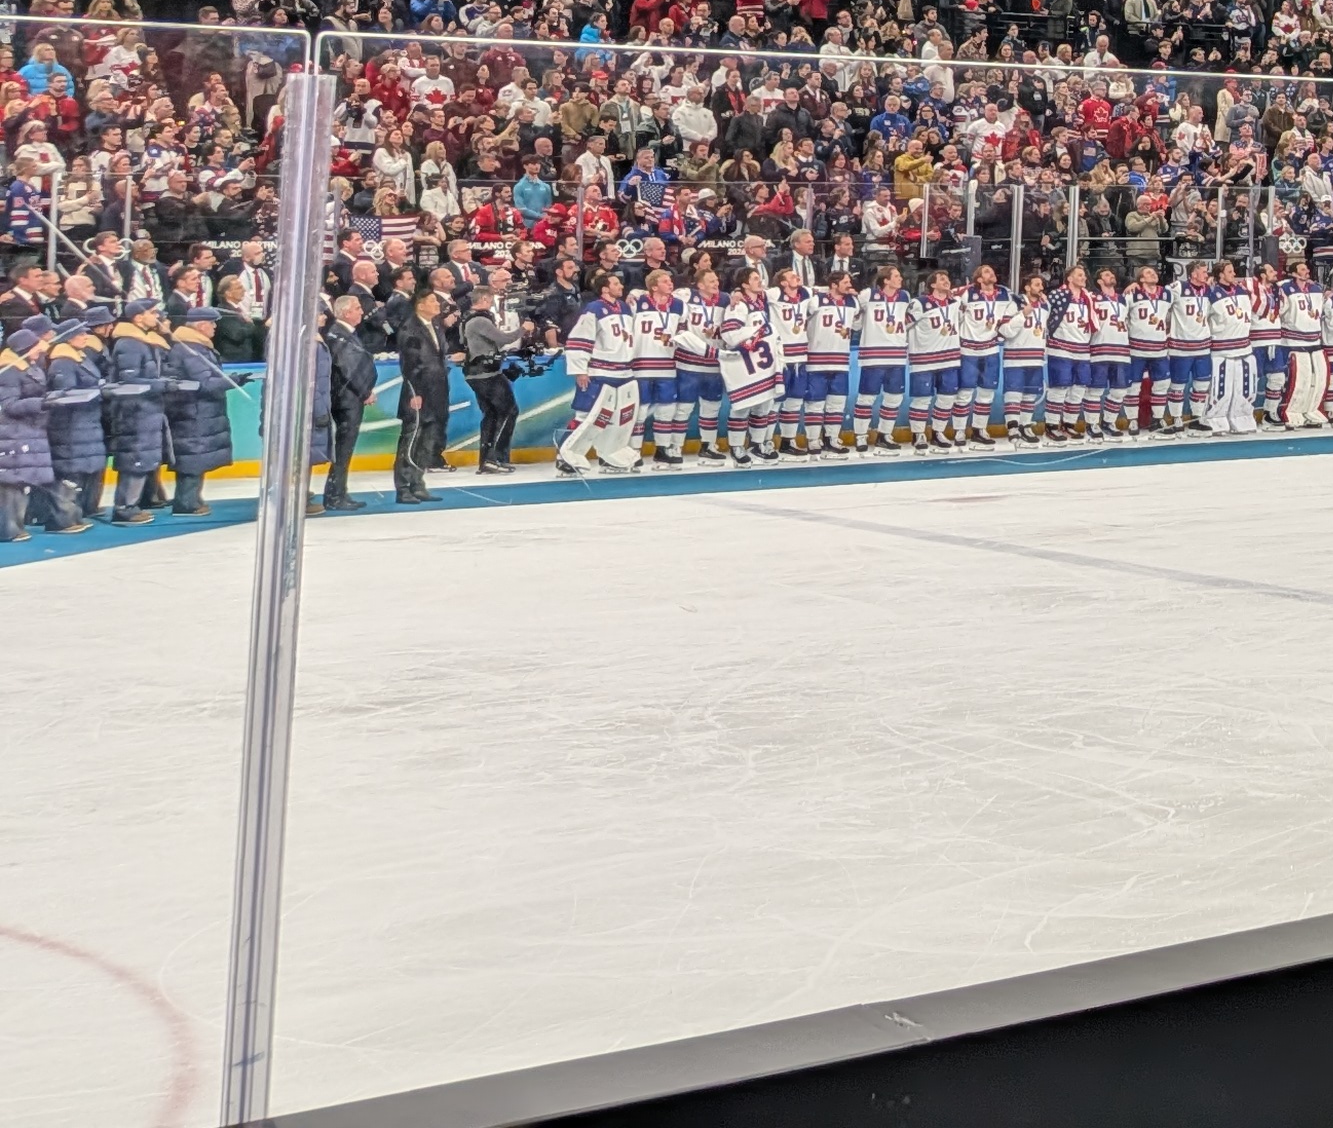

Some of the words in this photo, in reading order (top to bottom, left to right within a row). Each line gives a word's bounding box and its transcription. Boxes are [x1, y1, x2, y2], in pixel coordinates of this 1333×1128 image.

[466, 241, 504, 250] MILANO
[697, 239, 737, 248] MILANO
[736, 338, 774, 375] 13
